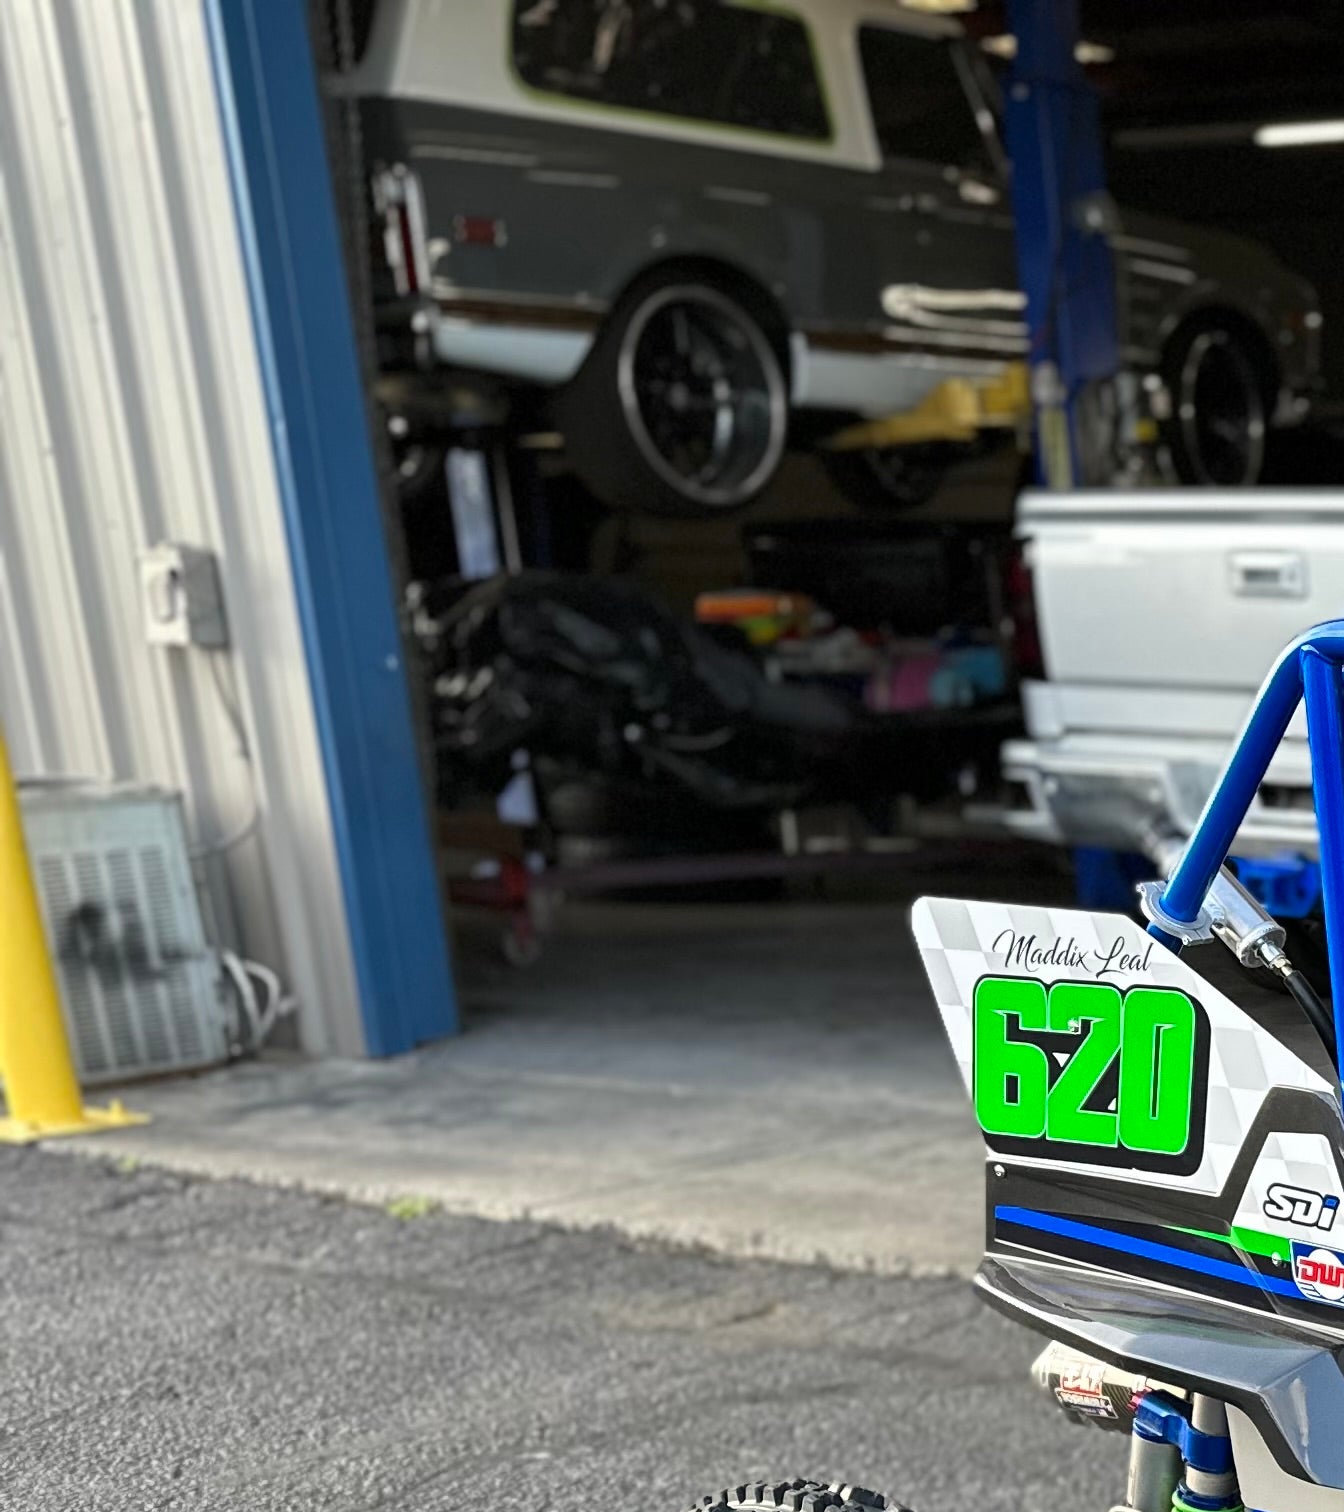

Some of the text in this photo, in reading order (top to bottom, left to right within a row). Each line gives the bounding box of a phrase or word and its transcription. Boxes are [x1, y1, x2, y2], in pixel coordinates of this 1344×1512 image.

[992, 929, 1152, 978] Maddix Leal
[973, 976, 1198, 1158] 620
